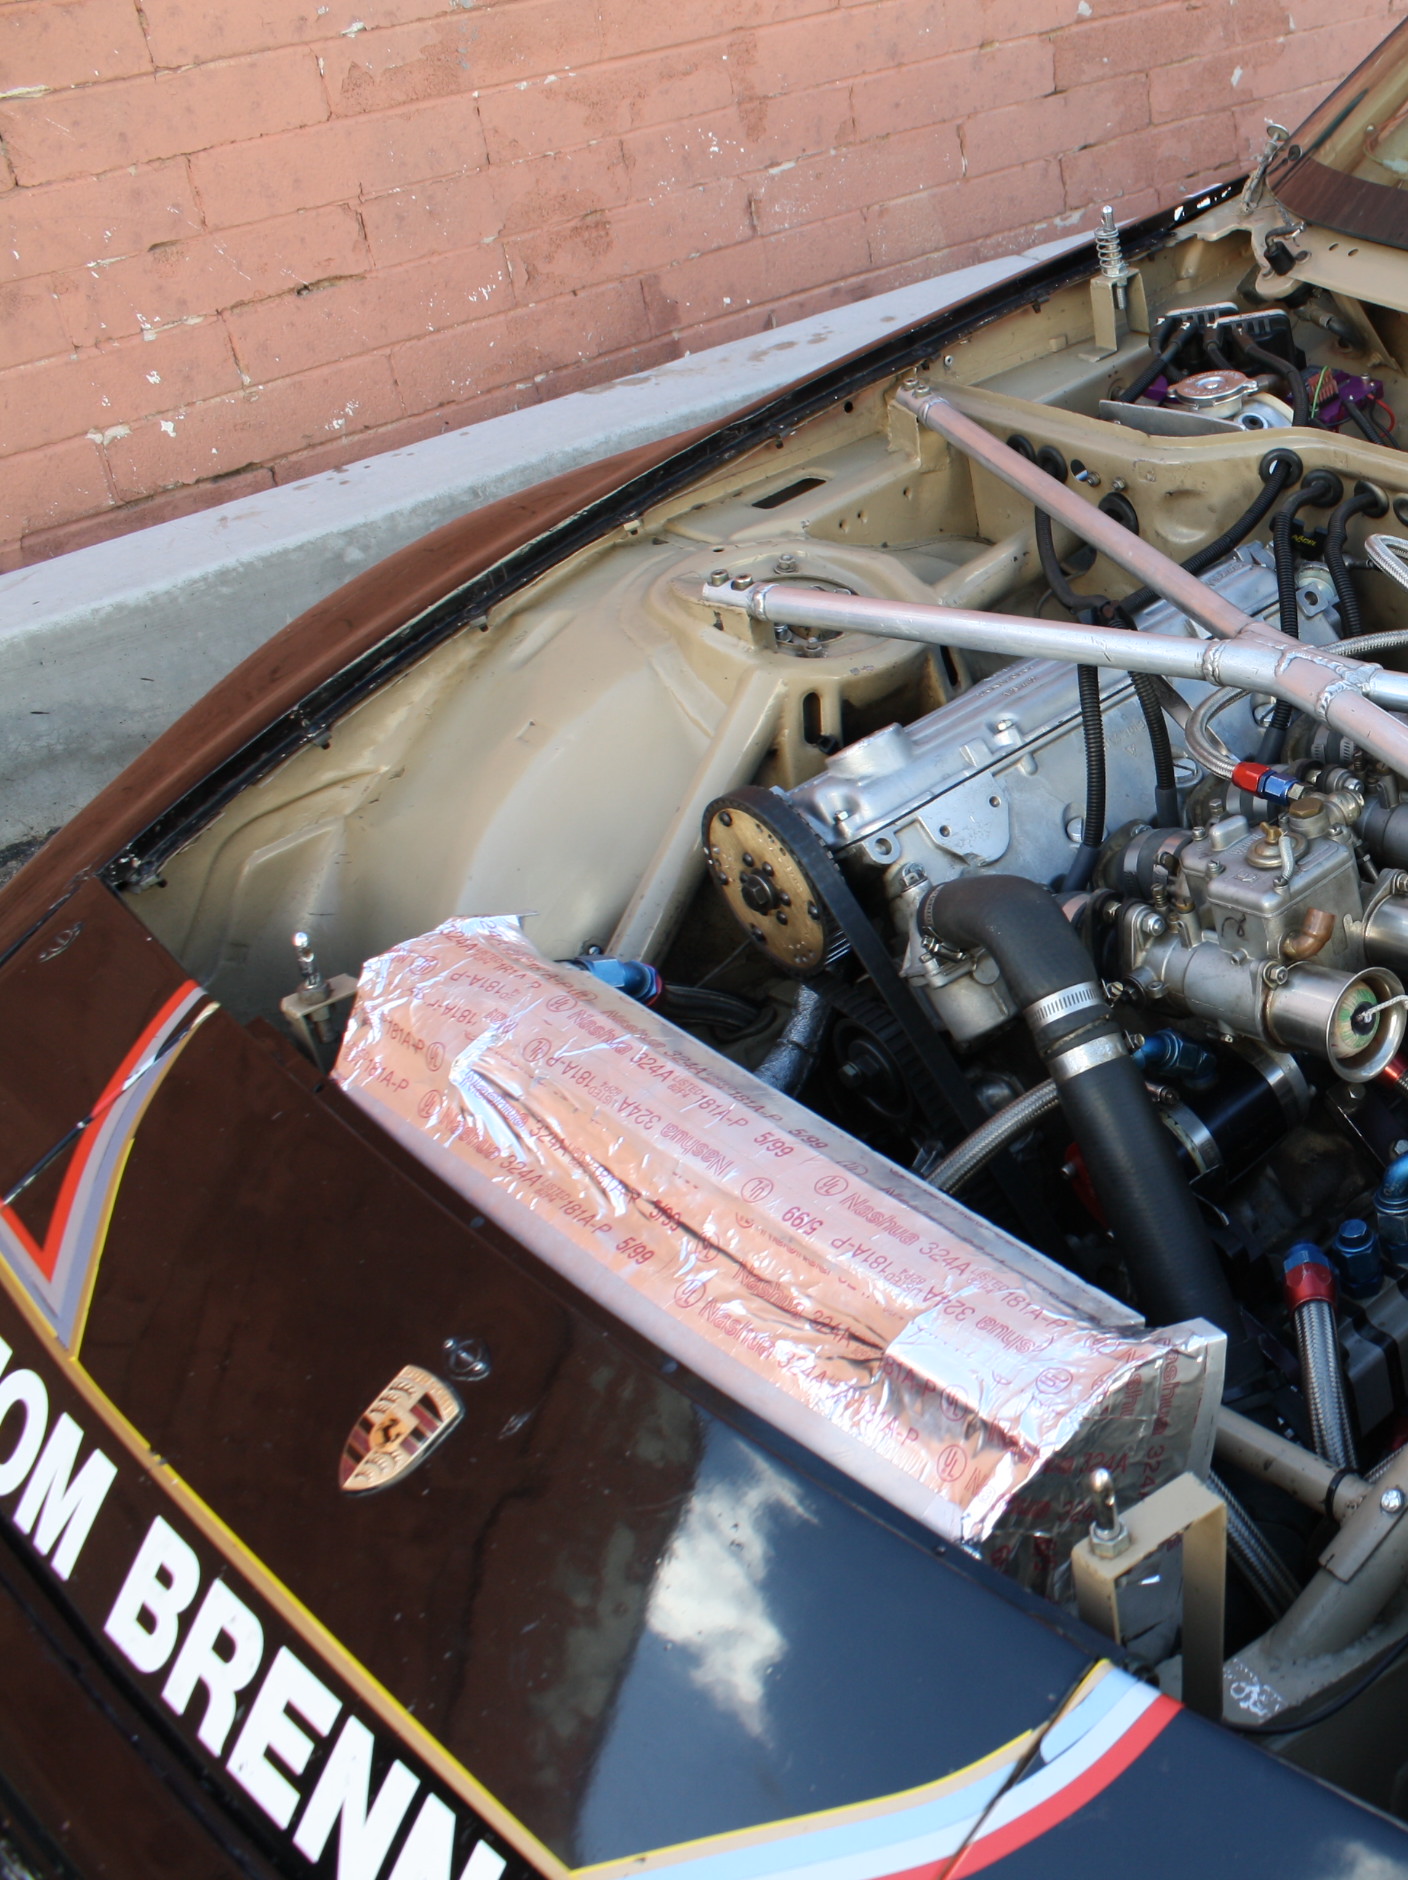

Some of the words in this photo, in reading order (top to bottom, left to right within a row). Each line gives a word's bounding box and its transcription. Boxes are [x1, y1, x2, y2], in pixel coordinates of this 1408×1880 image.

[545, 1052, 598, 1089] 181A-P
[615, 1096, 662, 1131] 324A
[628, 1048, 673, 1082] 324A
[692, 1092, 749, 1132] 181A-P
[754, 1129, 795, 1160] 5/99
[839, 1188, 920, 1247] Nashua
[917, 1238, 971, 1276] 324A
[657, 1122, 735, 1178] Nashua
[497, 1152, 543, 1188] 324A
[556, 1195, 613, 1239] 181A-P
[614, 1233, 656, 1267] 5/99
[780, 1205, 824, 1236] 5/99
[830, 1232, 894, 1274] 181A-P
[920, 1287, 977, 1324] 324A
[0, 1337, 118, 1581] OM
